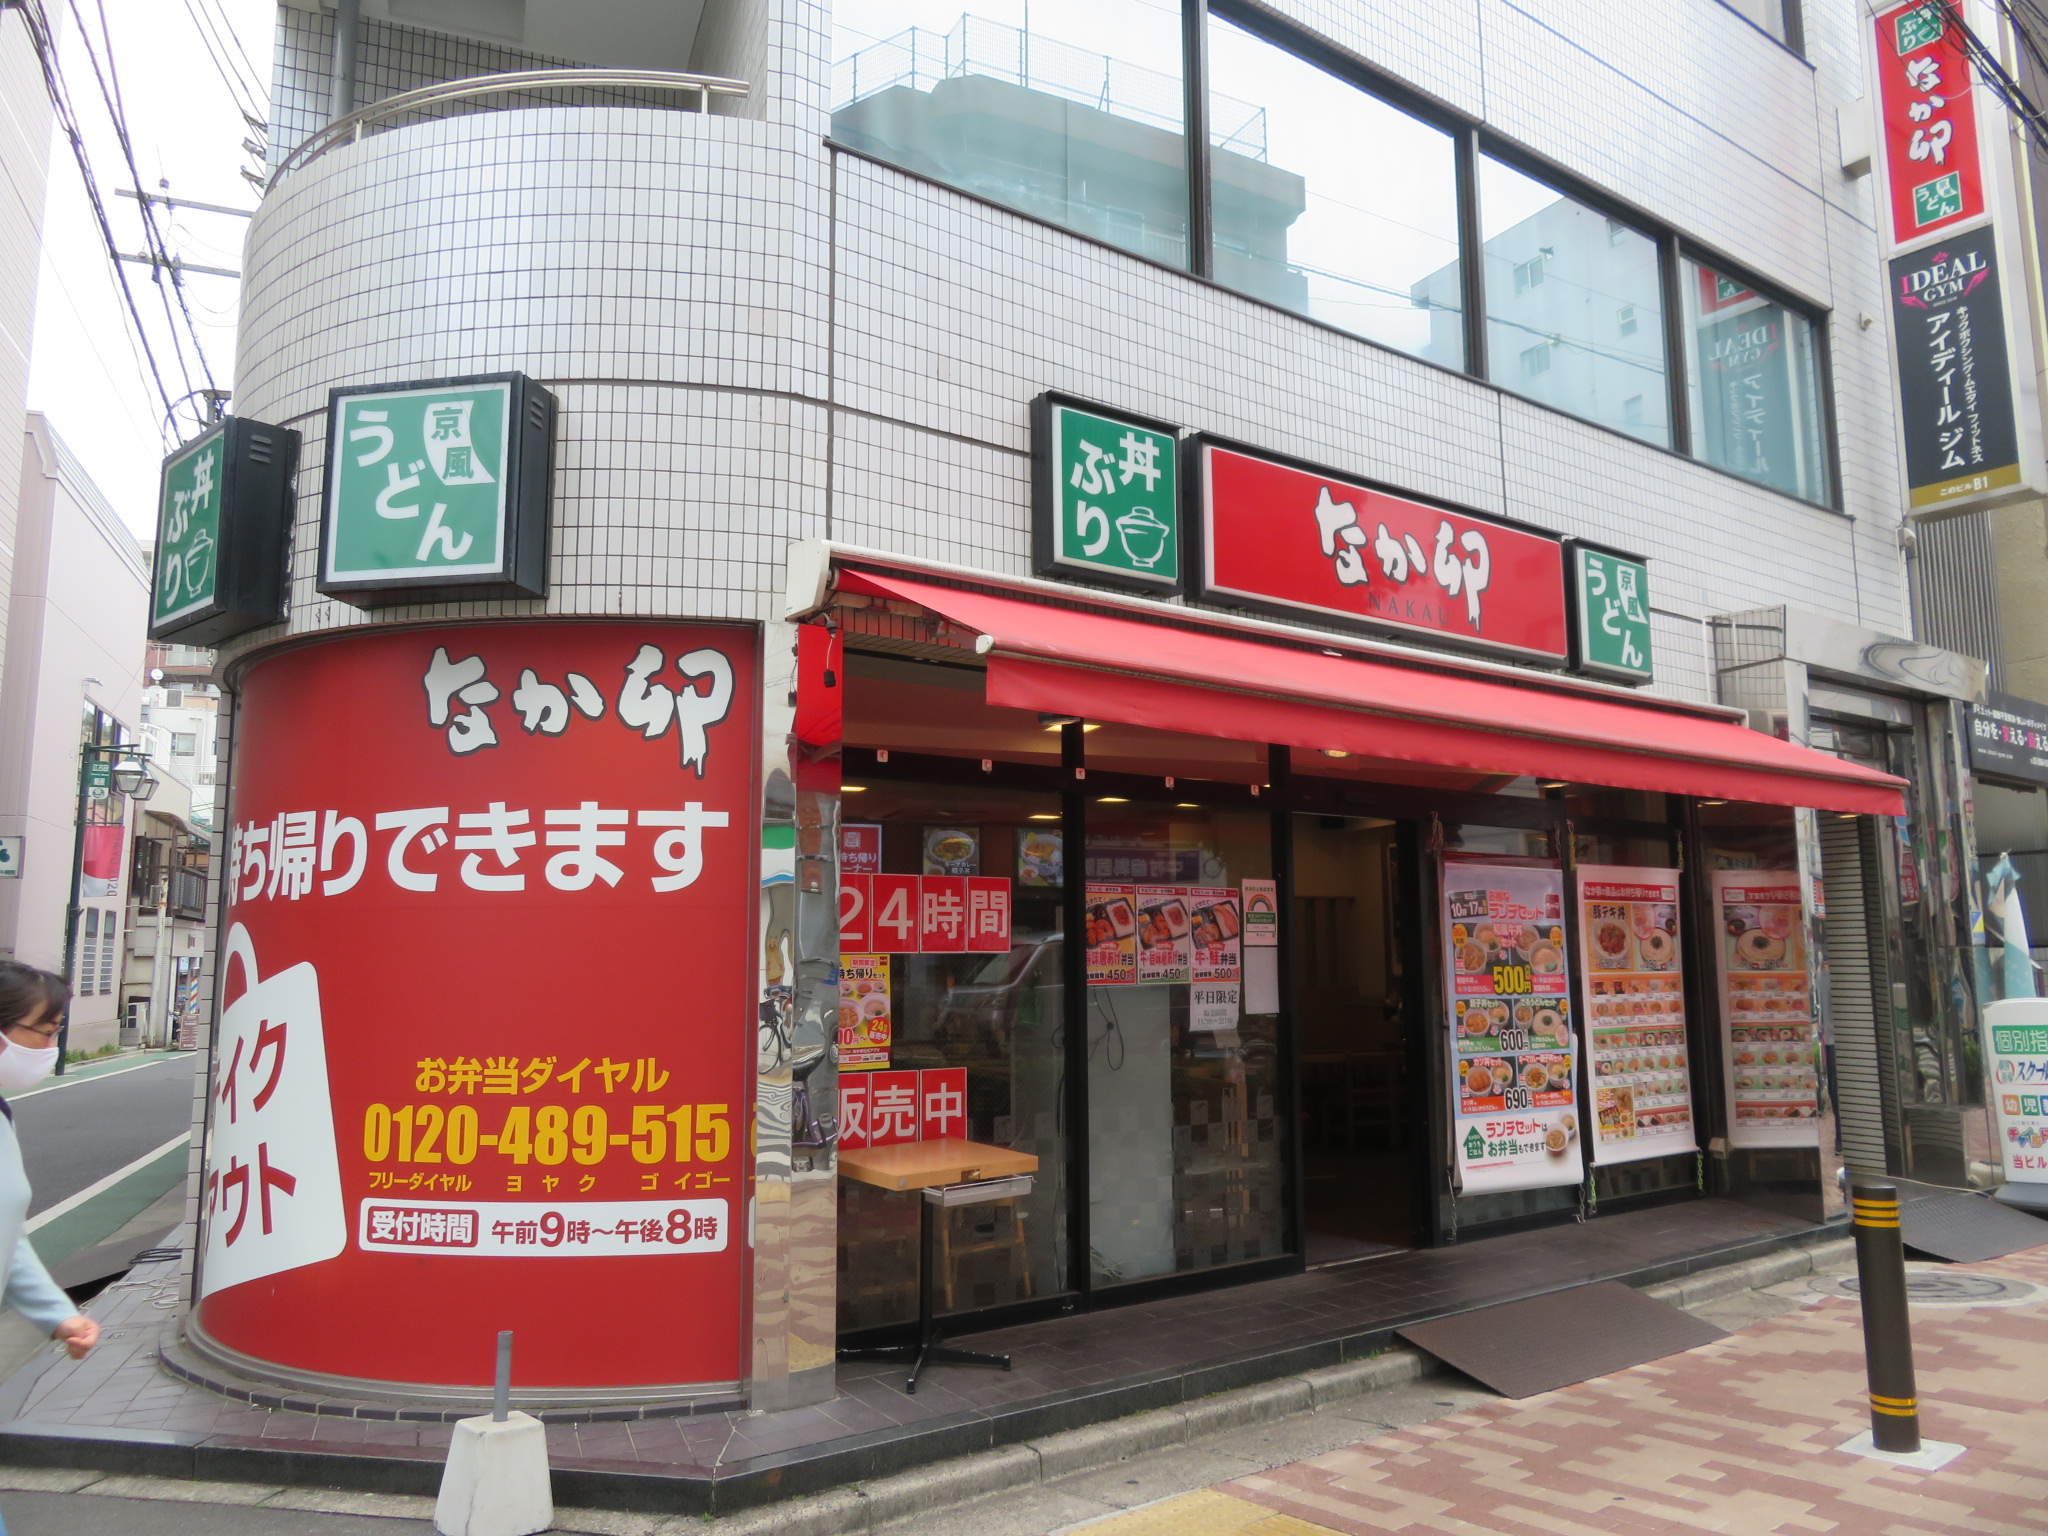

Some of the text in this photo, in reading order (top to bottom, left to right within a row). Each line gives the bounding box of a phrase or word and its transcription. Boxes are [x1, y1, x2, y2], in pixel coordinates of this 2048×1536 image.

[1906, 56, 1953, 166] なか卯
[1917, 187, 1955, 216] うどん
[1901, 251, 1987, 295] IDEAL
[1924, 278, 1964, 301] GYM
[1926, 311, 1962, 427] アイディール
[430, 406, 476, 479] 京風
[1938, 427, 1966, 470] ジム
[349, 409, 473, 563] うどん
[1070, 431, 1162, 556] 丼ぶり
[1973, 476, 1988, 490] B1
[162, 448, 215, 608] 丼ぶり
[1314, 485, 1490, 634] なか卯
[1368, 591, 1449, 625] NAKAU
[1587, 557, 1644, 668] うどん
[424, 643, 733, 779] なか卯
[840, 886, 1008, 941] 24時間
[1488, 902, 1545, 920] ランチセット
[1194, 990, 1238, 1004] 平日限定
[414, 1056, 670, 1096] お弁当ダイヤル
[363, 1102, 730, 1167] 0120-489-515
[1486, 1118, 1547, 1138] ランチセットは
[1488, 1138, 1546, 1157] お弁当もできます
[368, 1172, 473, 1193] フリーダイヤル
[370, 1211, 474, 1244] 受付時間
[490, 1209, 719, 1250] 午前9時〜午後8時
